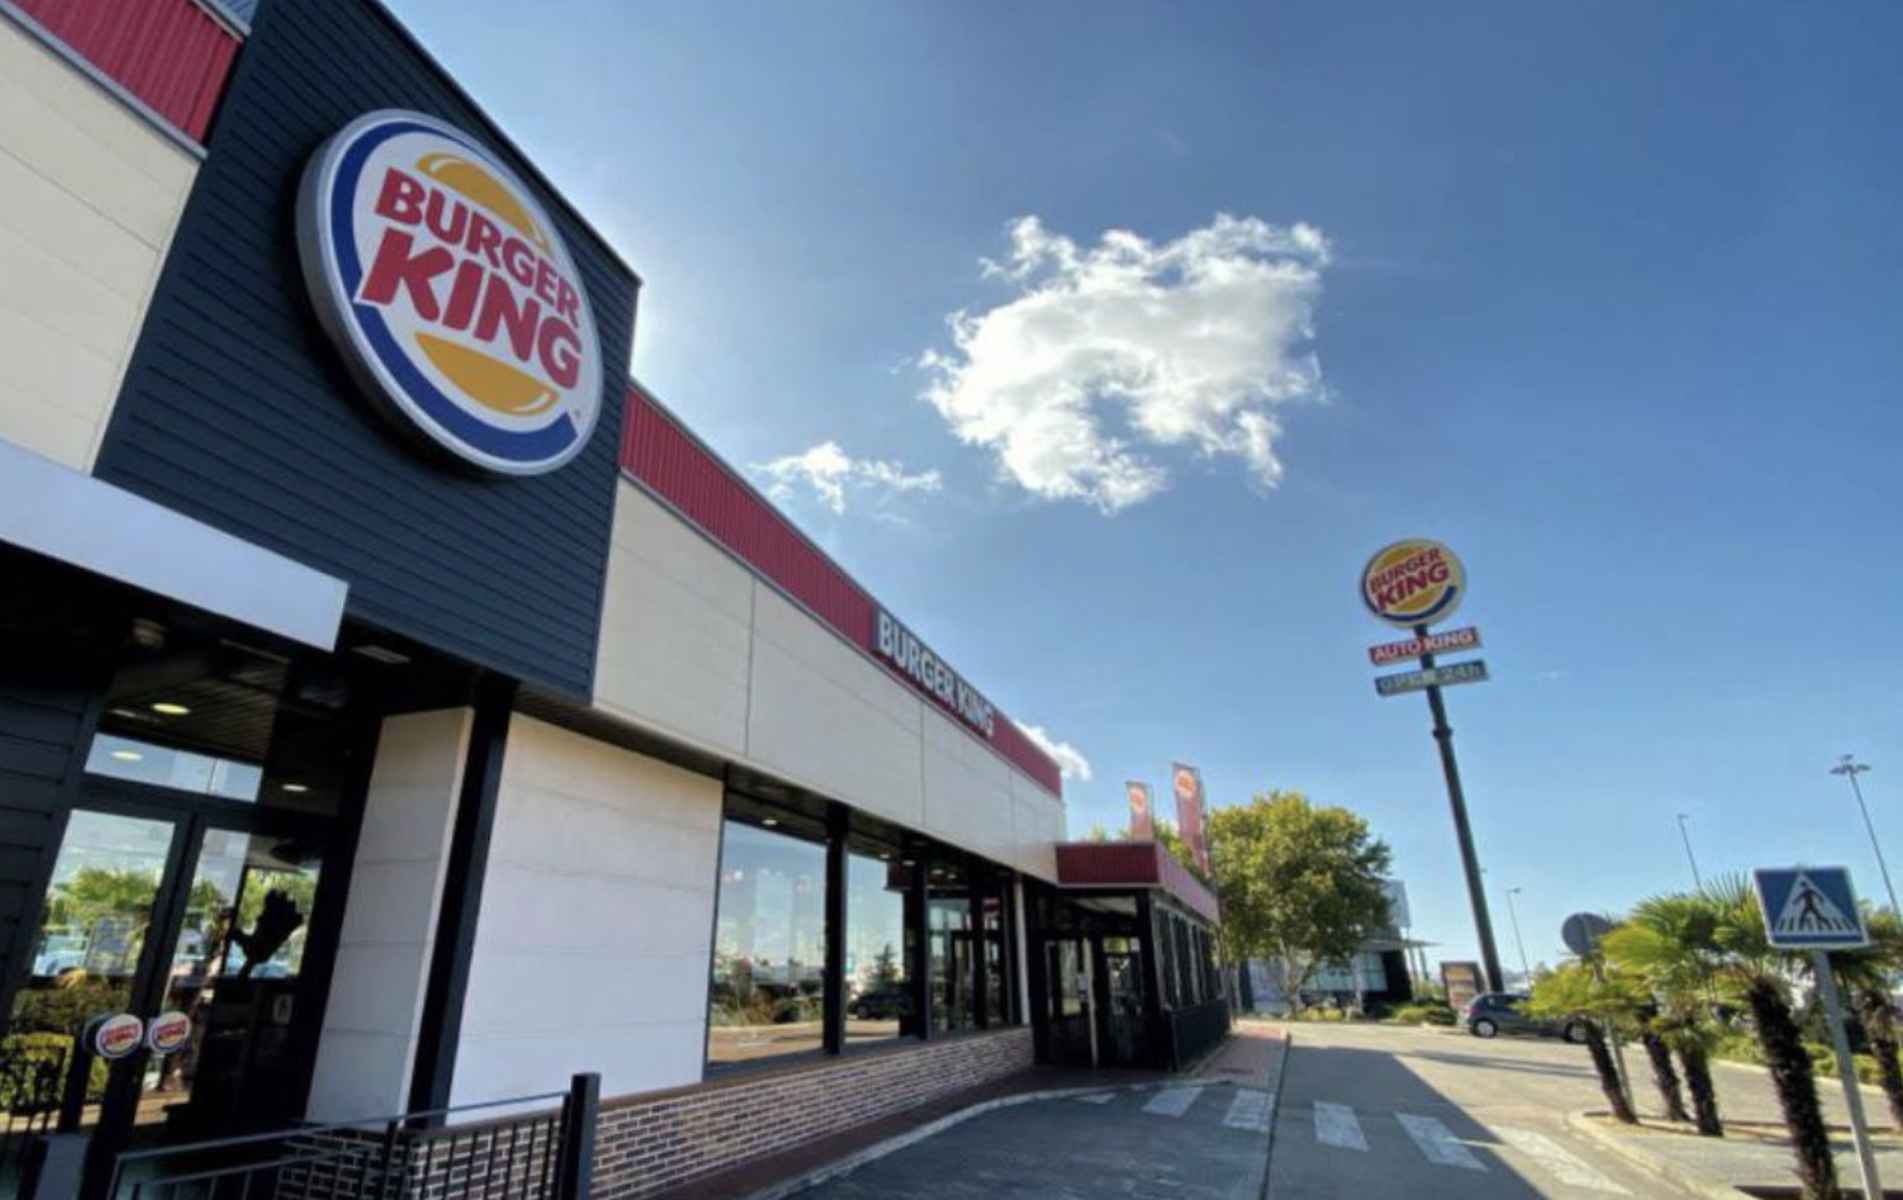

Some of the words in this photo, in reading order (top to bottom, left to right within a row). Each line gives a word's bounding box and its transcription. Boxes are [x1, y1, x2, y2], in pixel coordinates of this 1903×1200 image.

[374, 166, 580, 329] BURGER
[361, 226, 583, 390] KING
[1370, 547, 1442, 593] BURGER
[1375, 560, 1450, 612] KING
[879, 608, 957, 707] BURGER
[1375, 640, 1421, 663] AUTO
